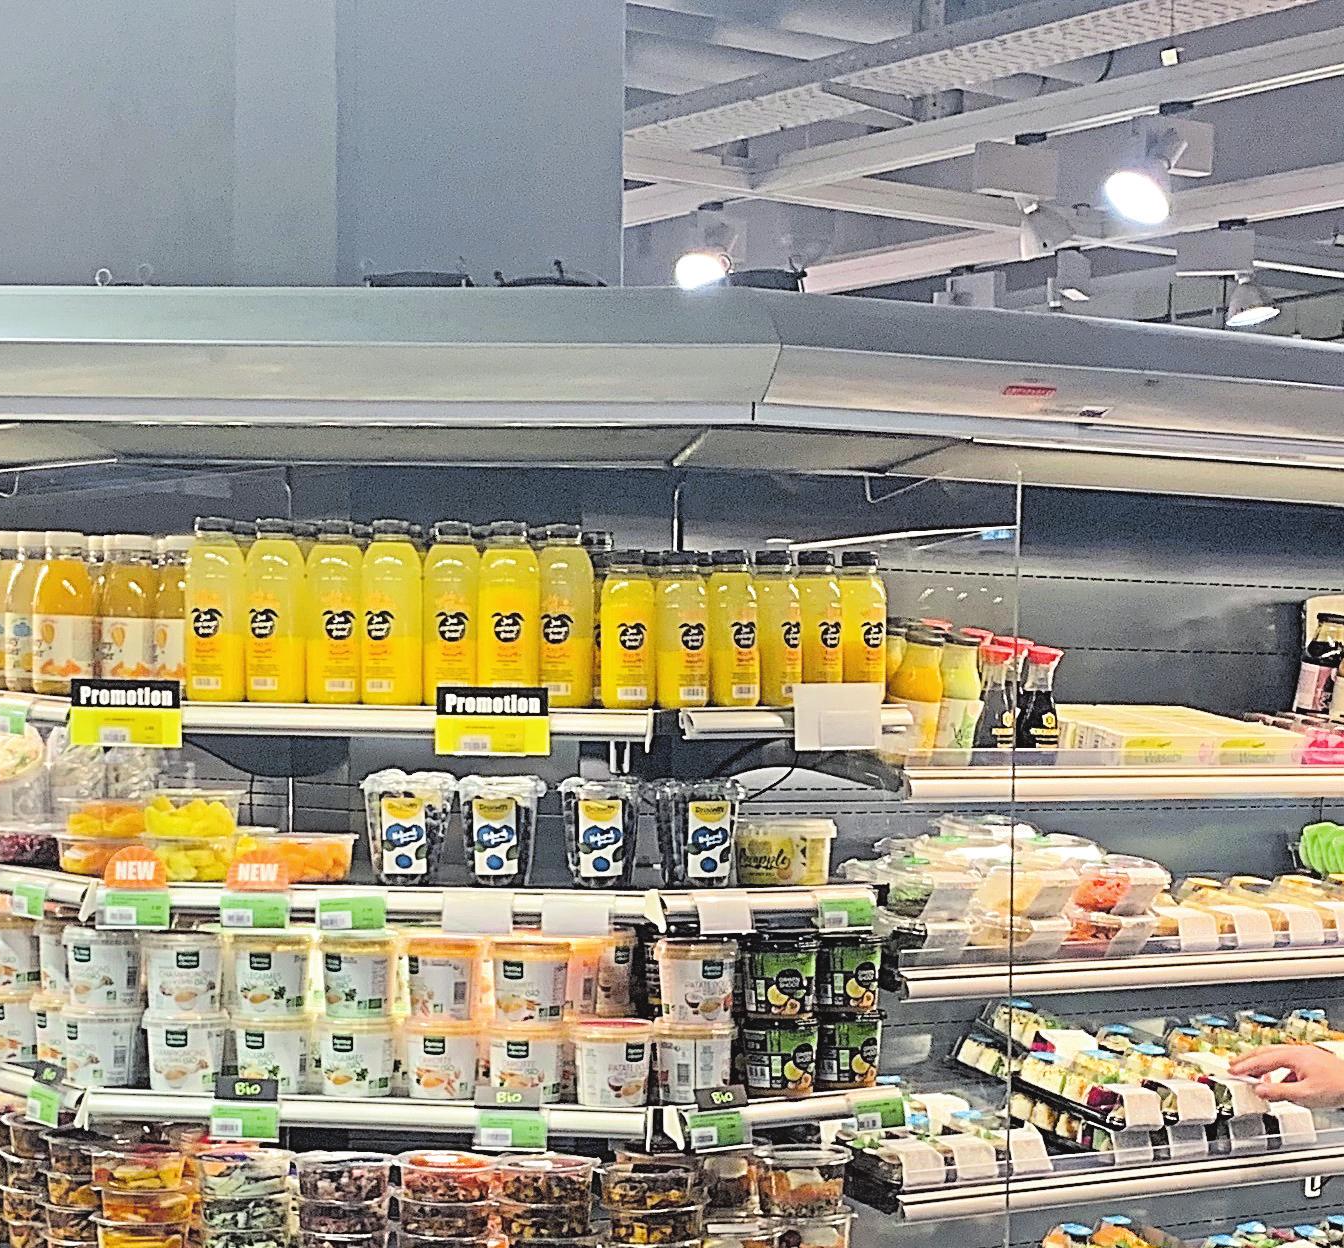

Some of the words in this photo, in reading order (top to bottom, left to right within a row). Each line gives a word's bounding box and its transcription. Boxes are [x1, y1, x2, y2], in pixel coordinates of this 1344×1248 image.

[80, 685, 173, 707] Promotion
[445, 693, 541, 714] Promotion
[115, 860, 156, 881] NEW
[238, 863, 278, 882] NEW
[234, 1082, 261, 1096] Bio
[495, 1091, 522, 1104] Bio
[711, 1091, 733, 1104] Bio
